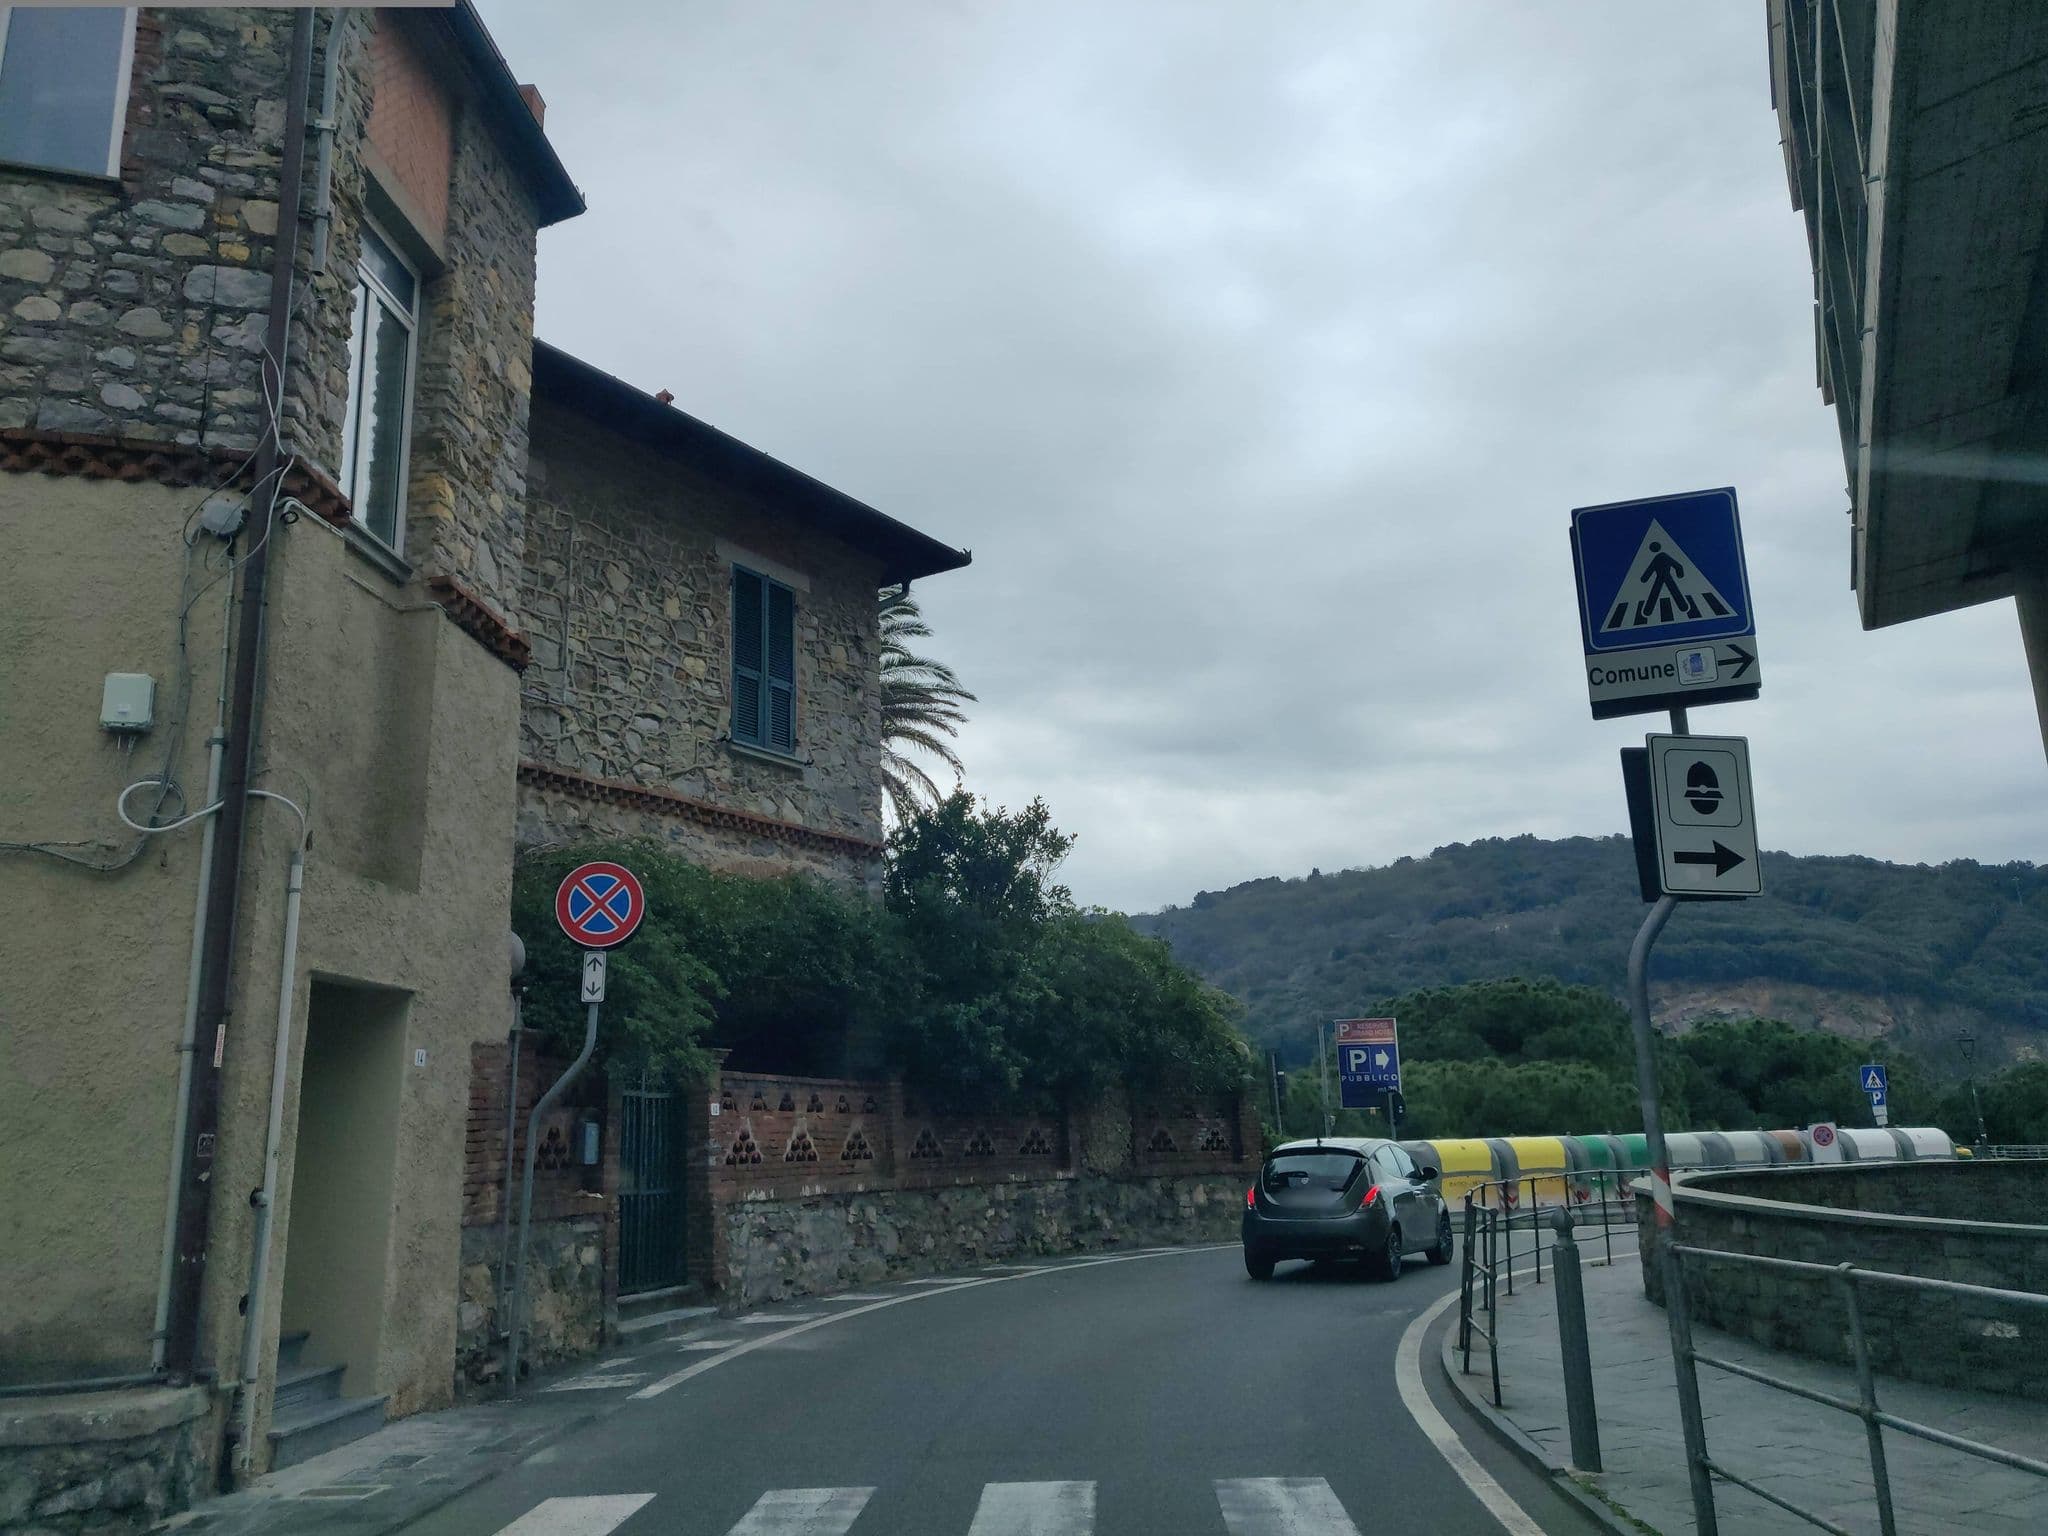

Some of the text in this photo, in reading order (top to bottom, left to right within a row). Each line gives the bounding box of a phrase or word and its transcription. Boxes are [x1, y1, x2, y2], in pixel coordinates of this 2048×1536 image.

[1589, 663, 1675, 685] Comune
[1340, 1024, 1349, 1036] P
[1350, 1050, 1366, 1071] P
[1873, 1092, 1881, 1104] P
